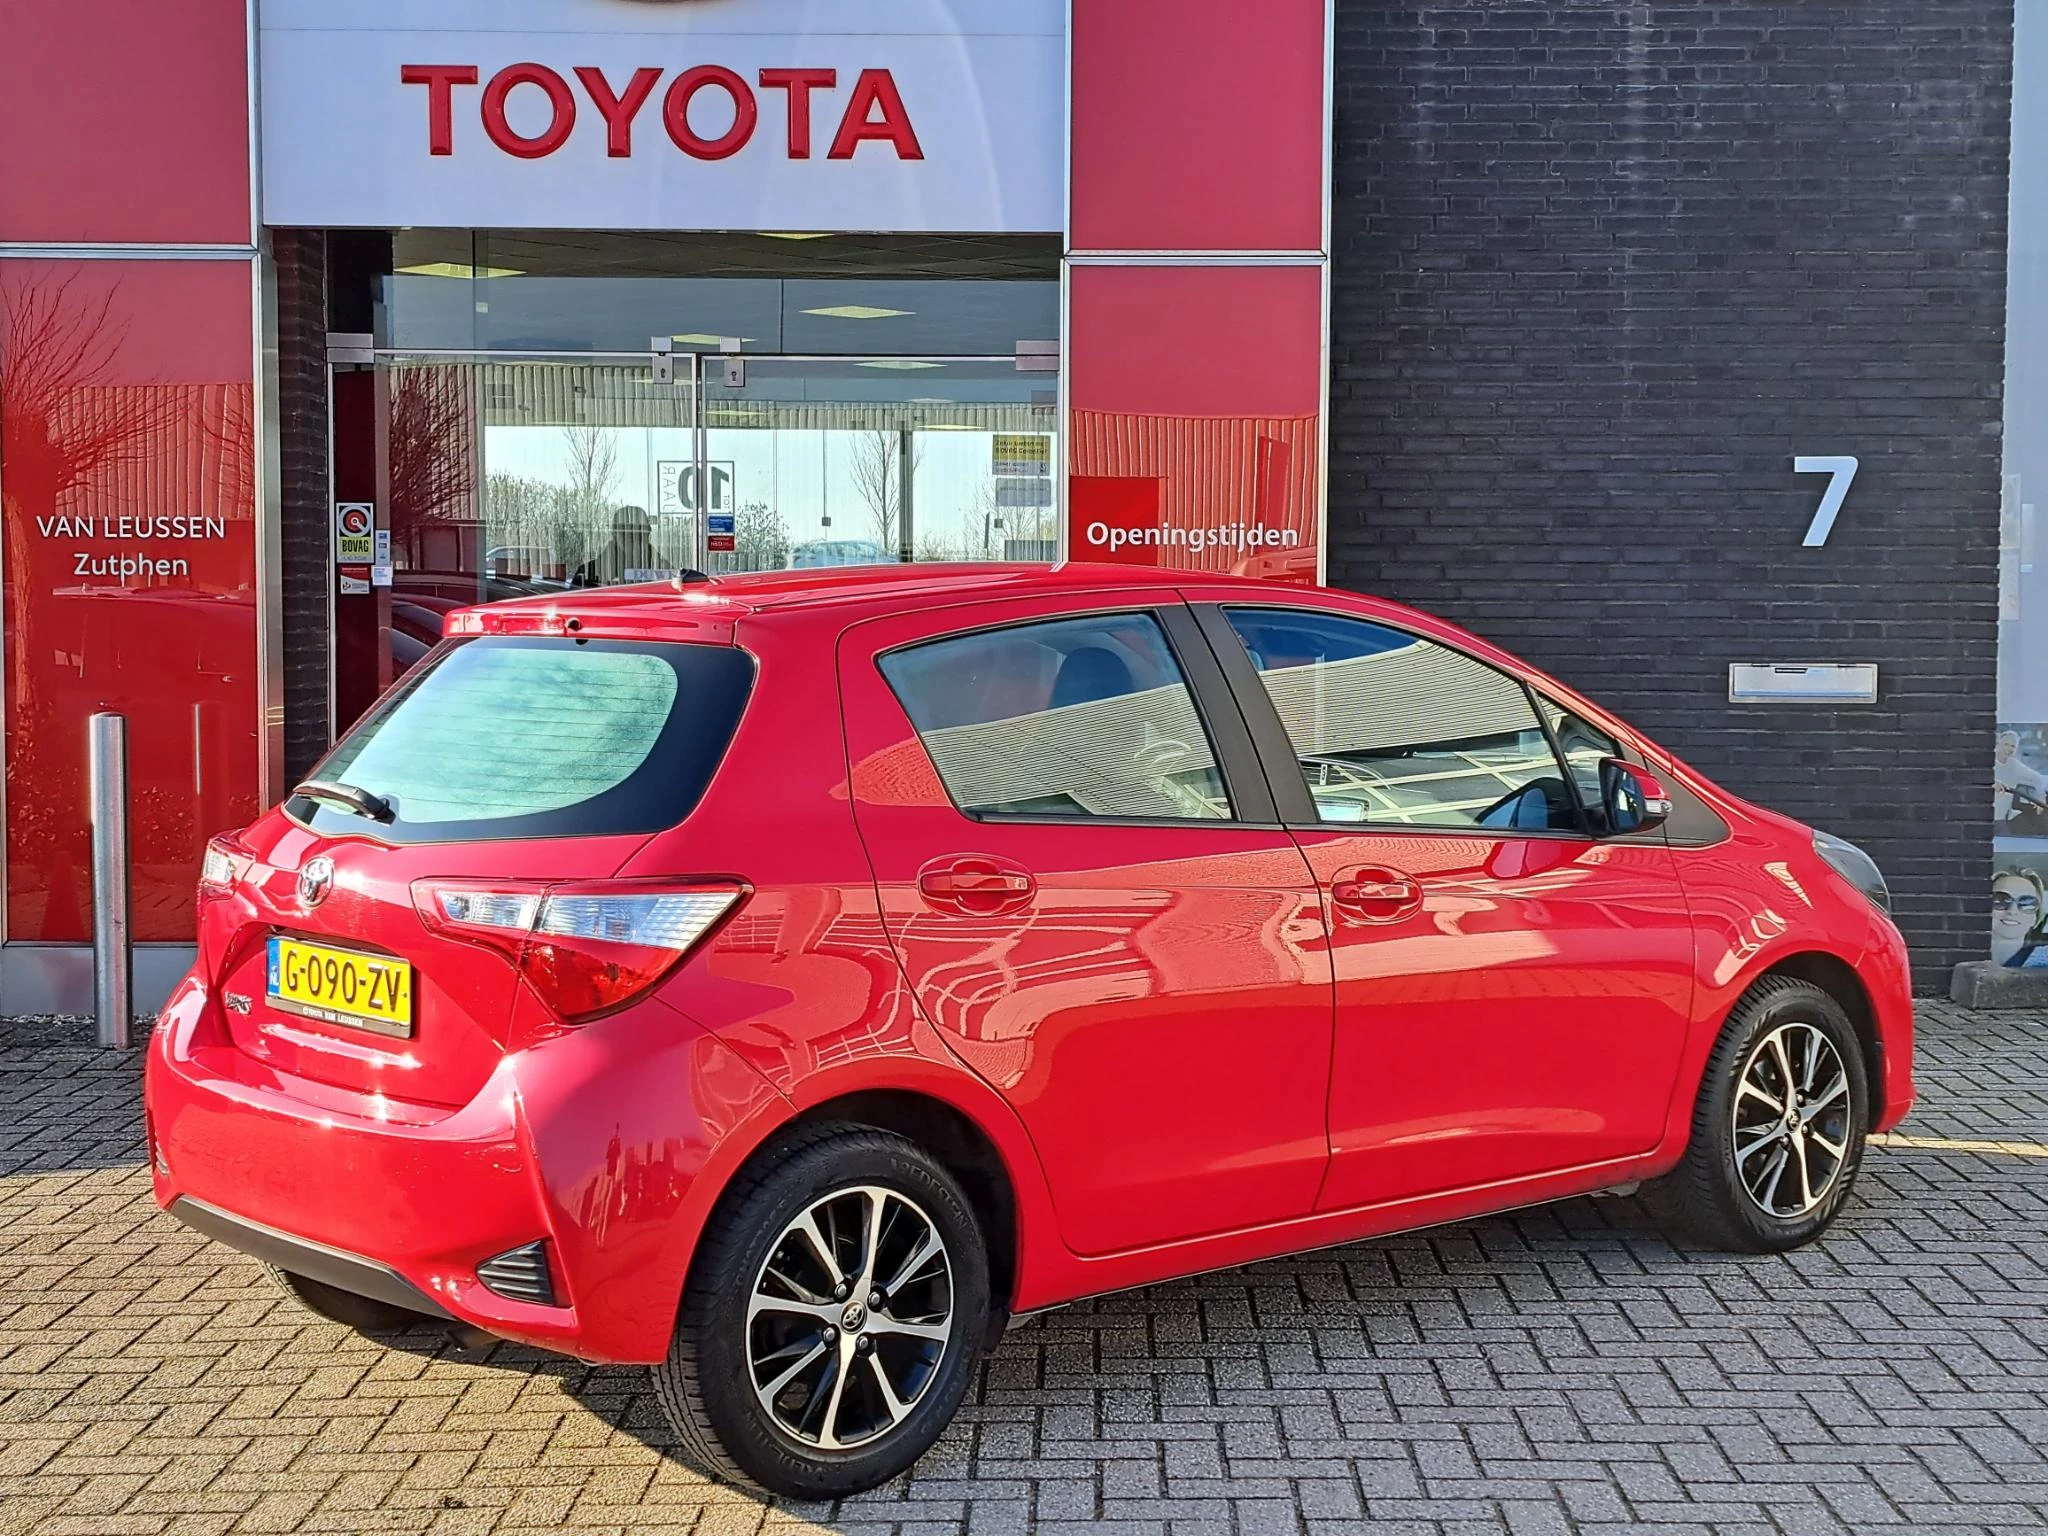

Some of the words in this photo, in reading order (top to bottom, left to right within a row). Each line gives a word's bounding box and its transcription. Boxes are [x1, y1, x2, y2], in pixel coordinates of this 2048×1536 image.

[400, 62, 925, 161] TOYOTA
[1794, 455, 1859, 547] 7
[36, 516, 94, 538] VAN
[104, 516, 225, 539] LEUSSEN
[1087, 522, 1298, 552] Openingstijden
[342, 539, 369, 553] BOVAG
[73, 552, 188, 581] Zutphen
[286, 949, 401, 1013] G-090-ZV
